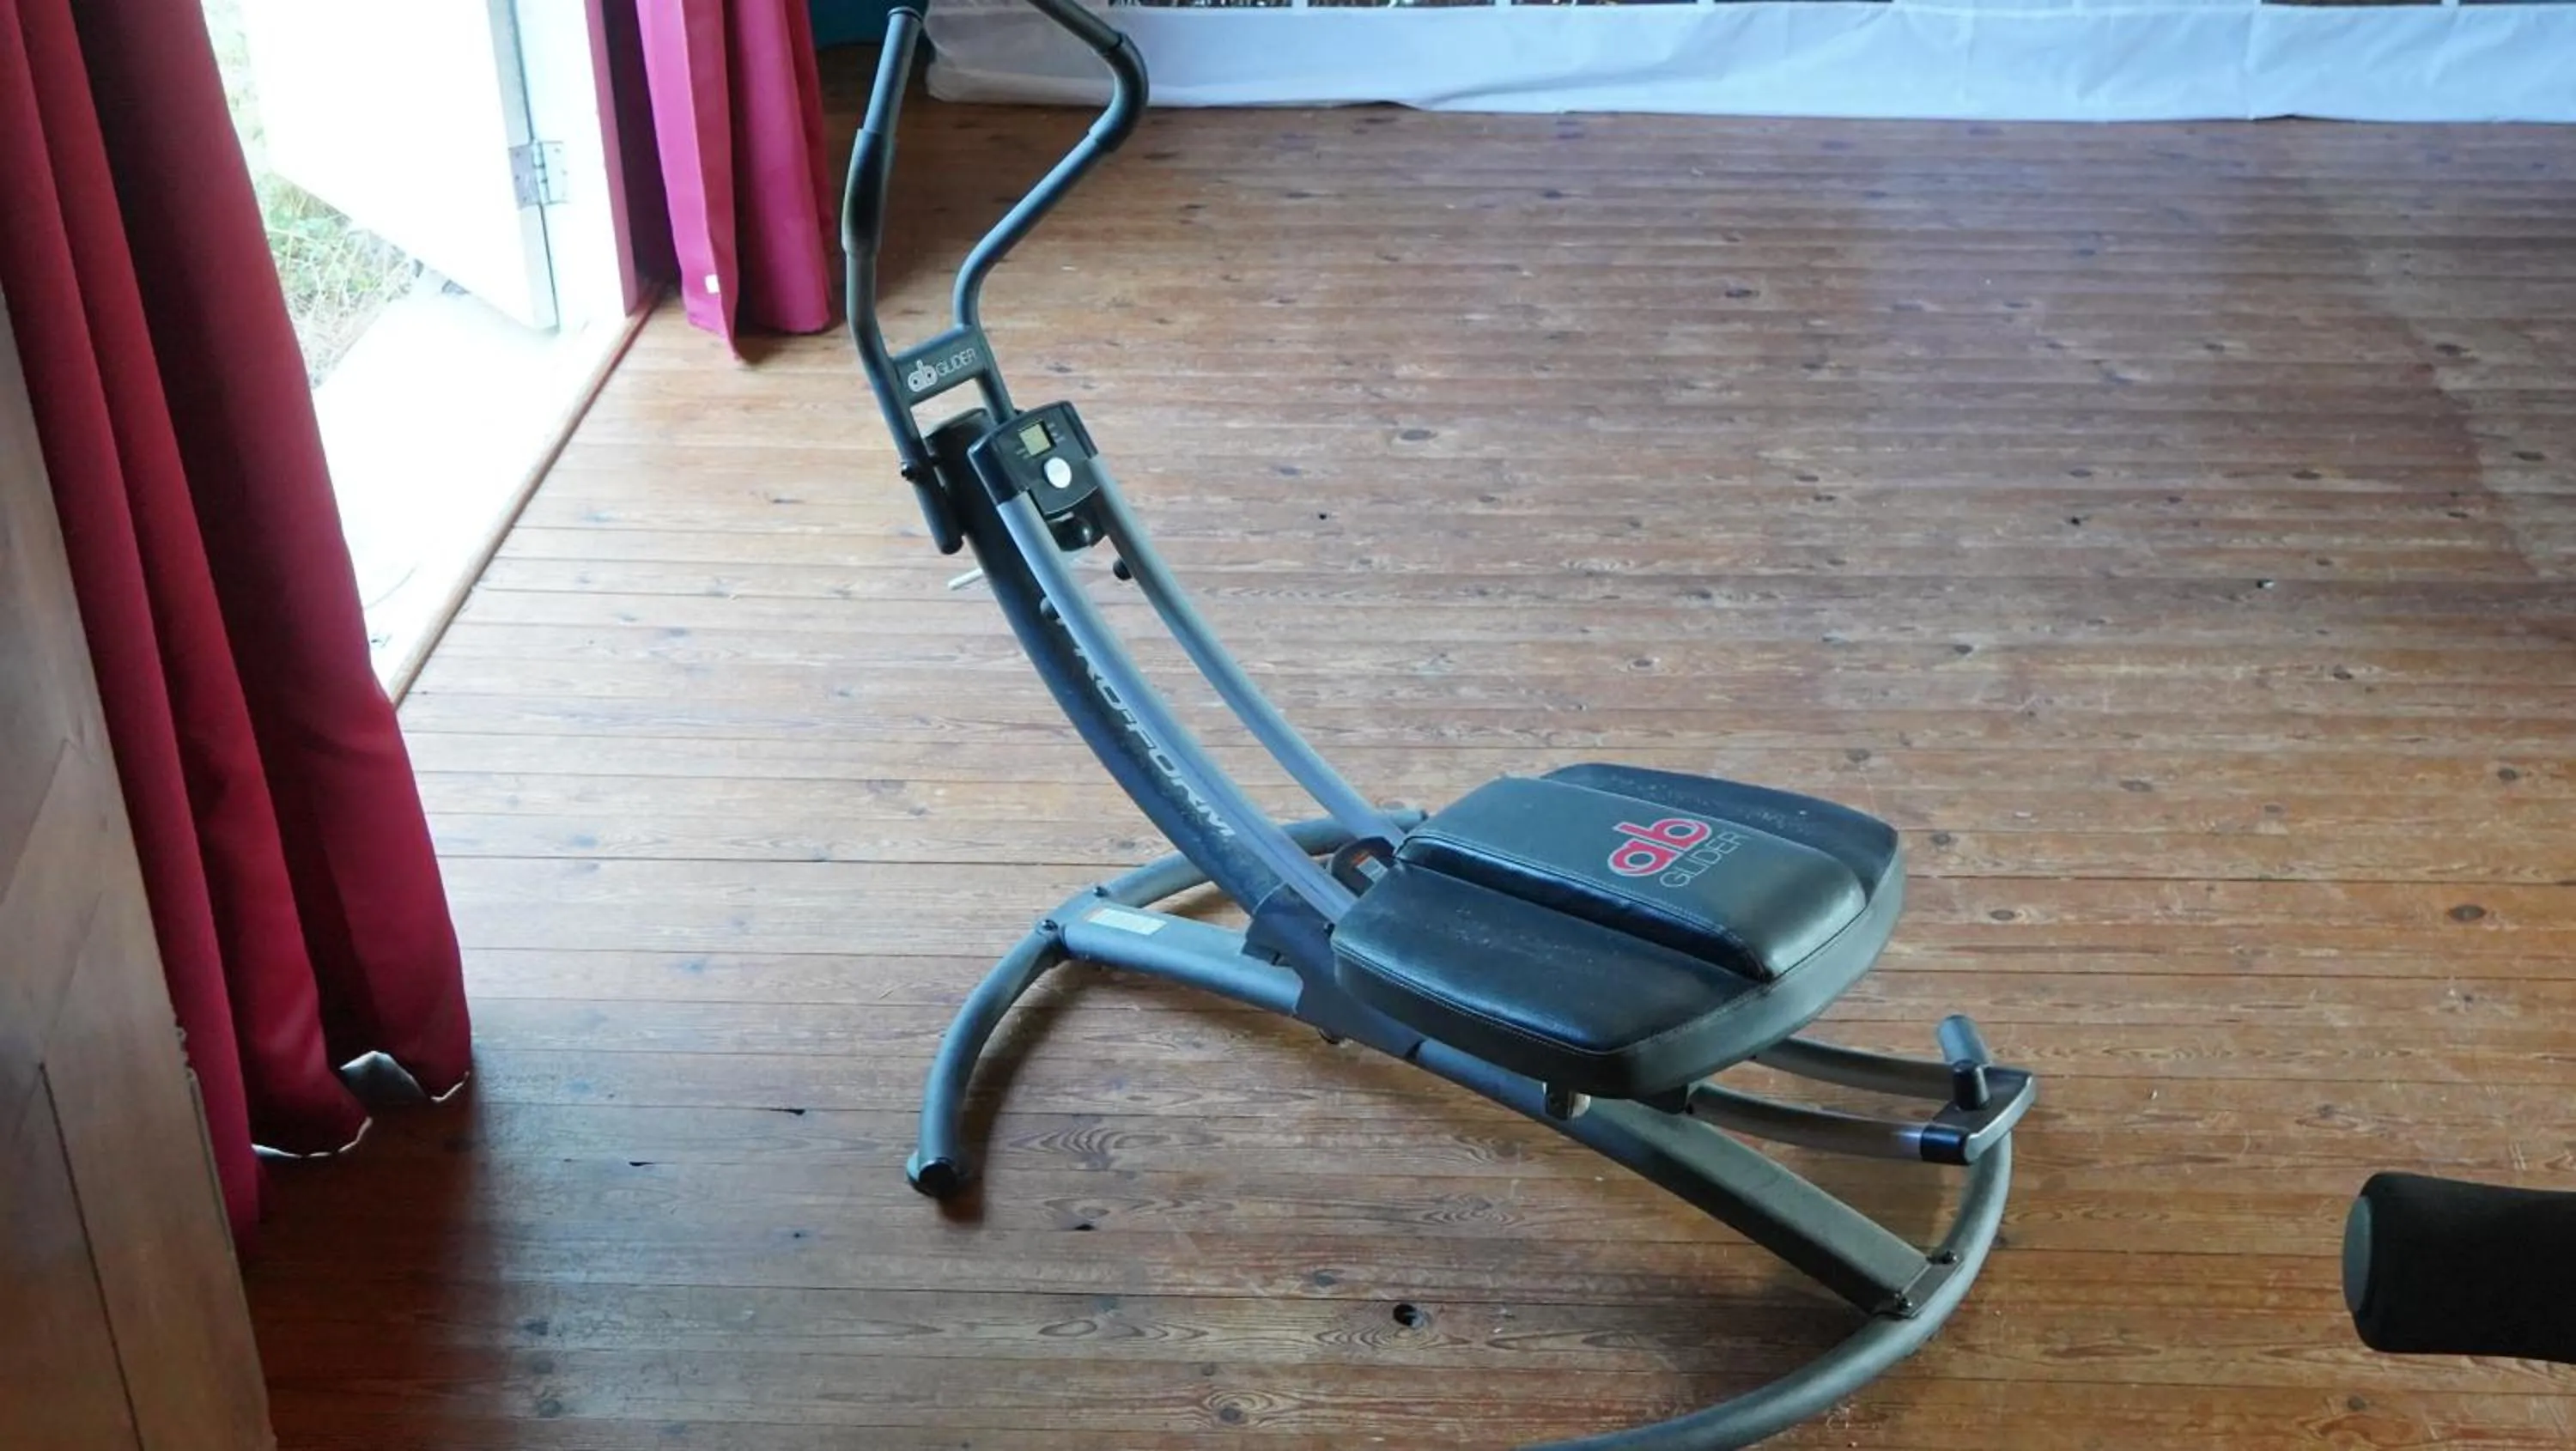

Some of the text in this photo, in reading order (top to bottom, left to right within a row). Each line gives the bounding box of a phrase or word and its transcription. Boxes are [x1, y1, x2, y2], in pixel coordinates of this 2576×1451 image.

[908, 348, 977, 392] ab GLIDER
[1607, 818, 1712, 877] ab
[1659, 831, 1751, 888] GLIDER
